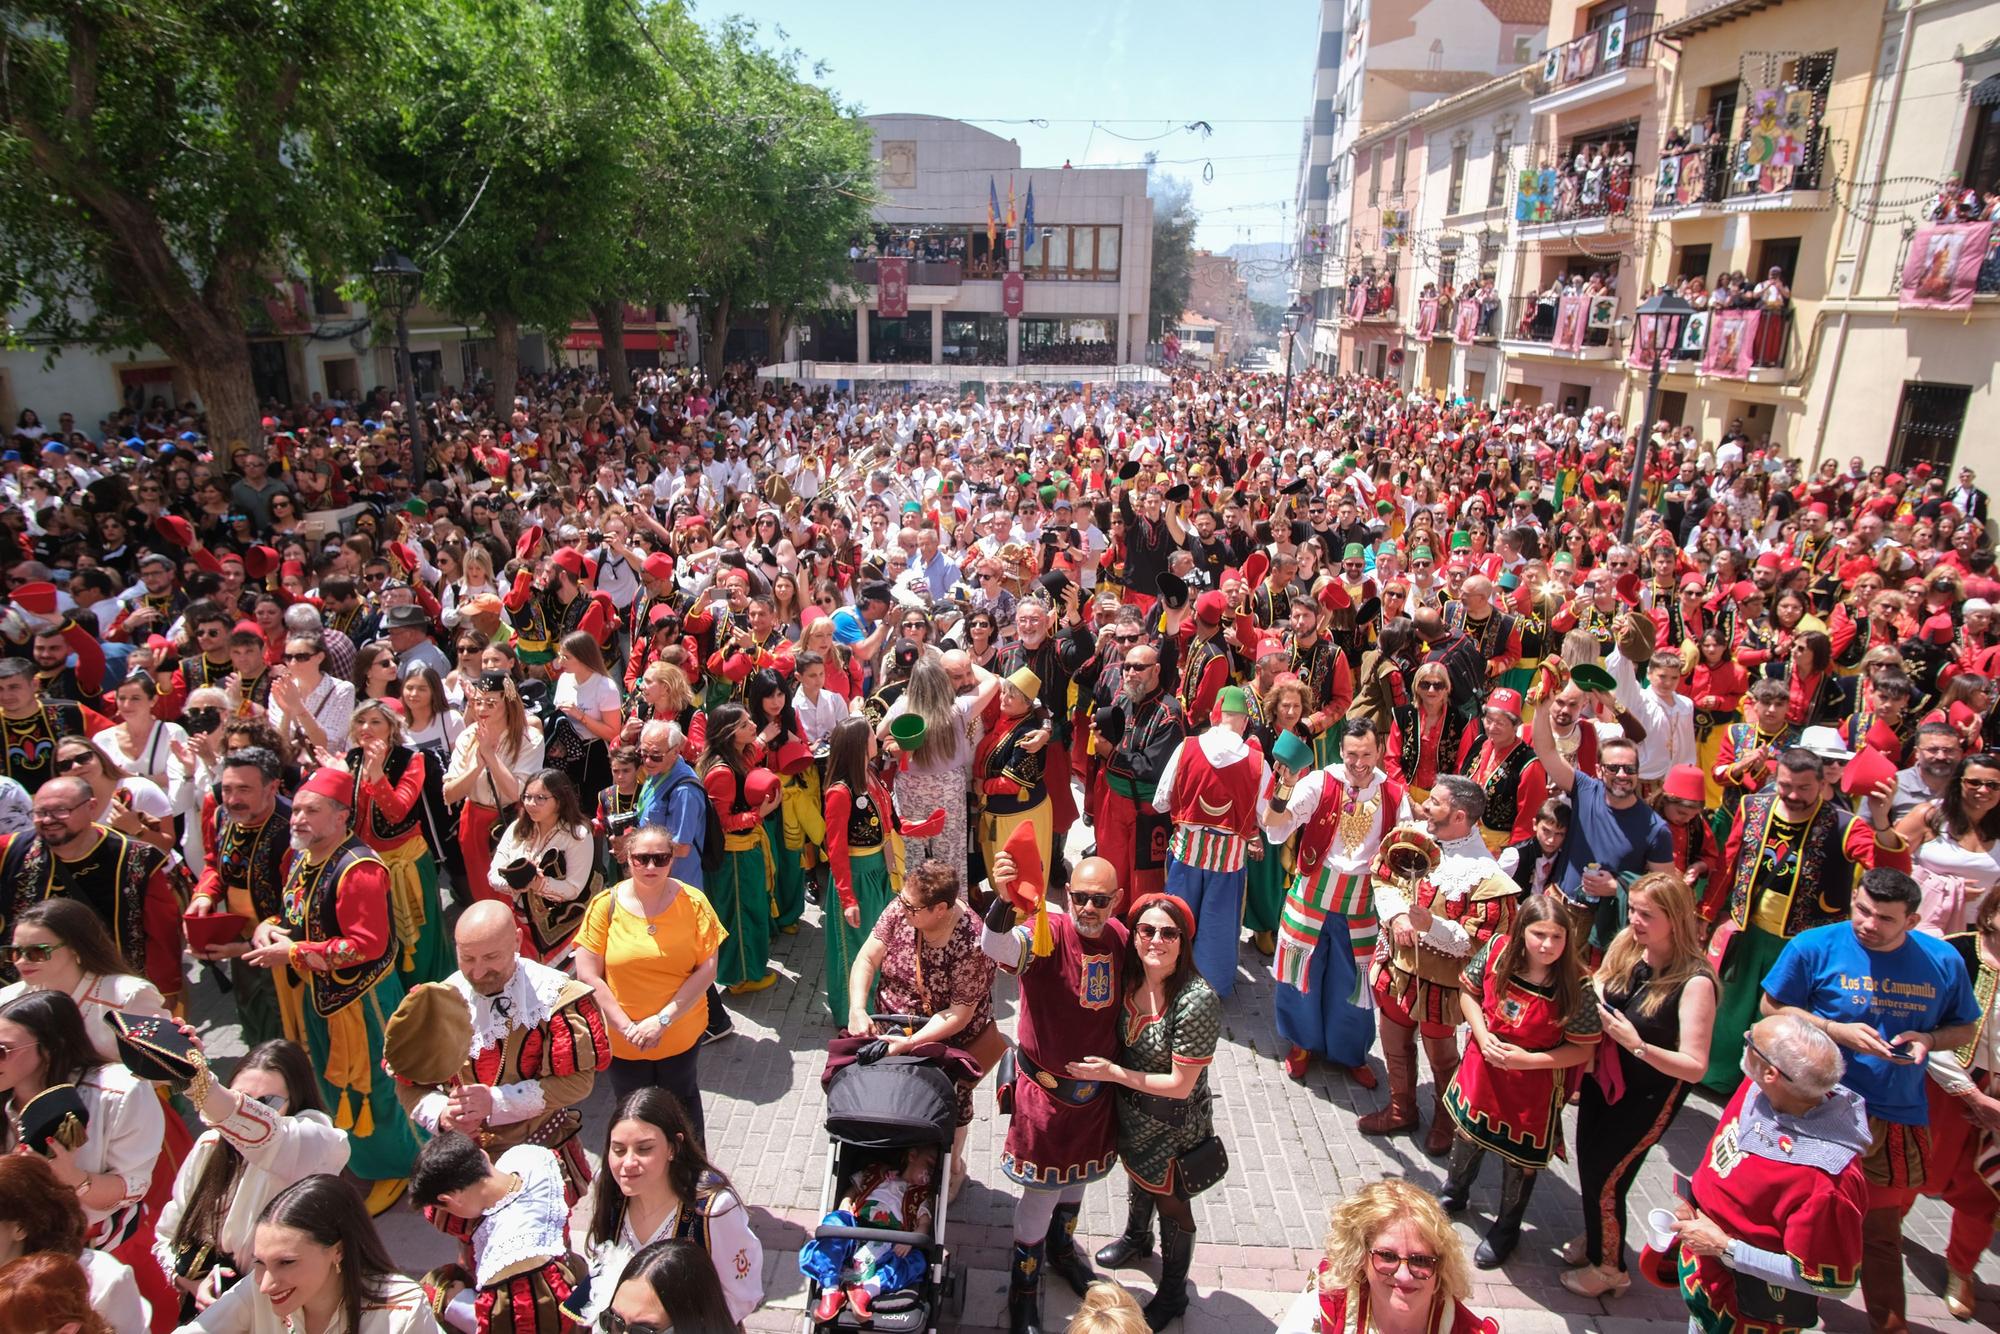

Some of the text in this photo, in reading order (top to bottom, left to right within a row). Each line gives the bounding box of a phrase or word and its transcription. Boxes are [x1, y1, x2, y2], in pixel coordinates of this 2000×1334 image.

[1840, 974, 1937, 999] Los De Campanilla
[1871, 996, 1928, 1012] Aniversario
